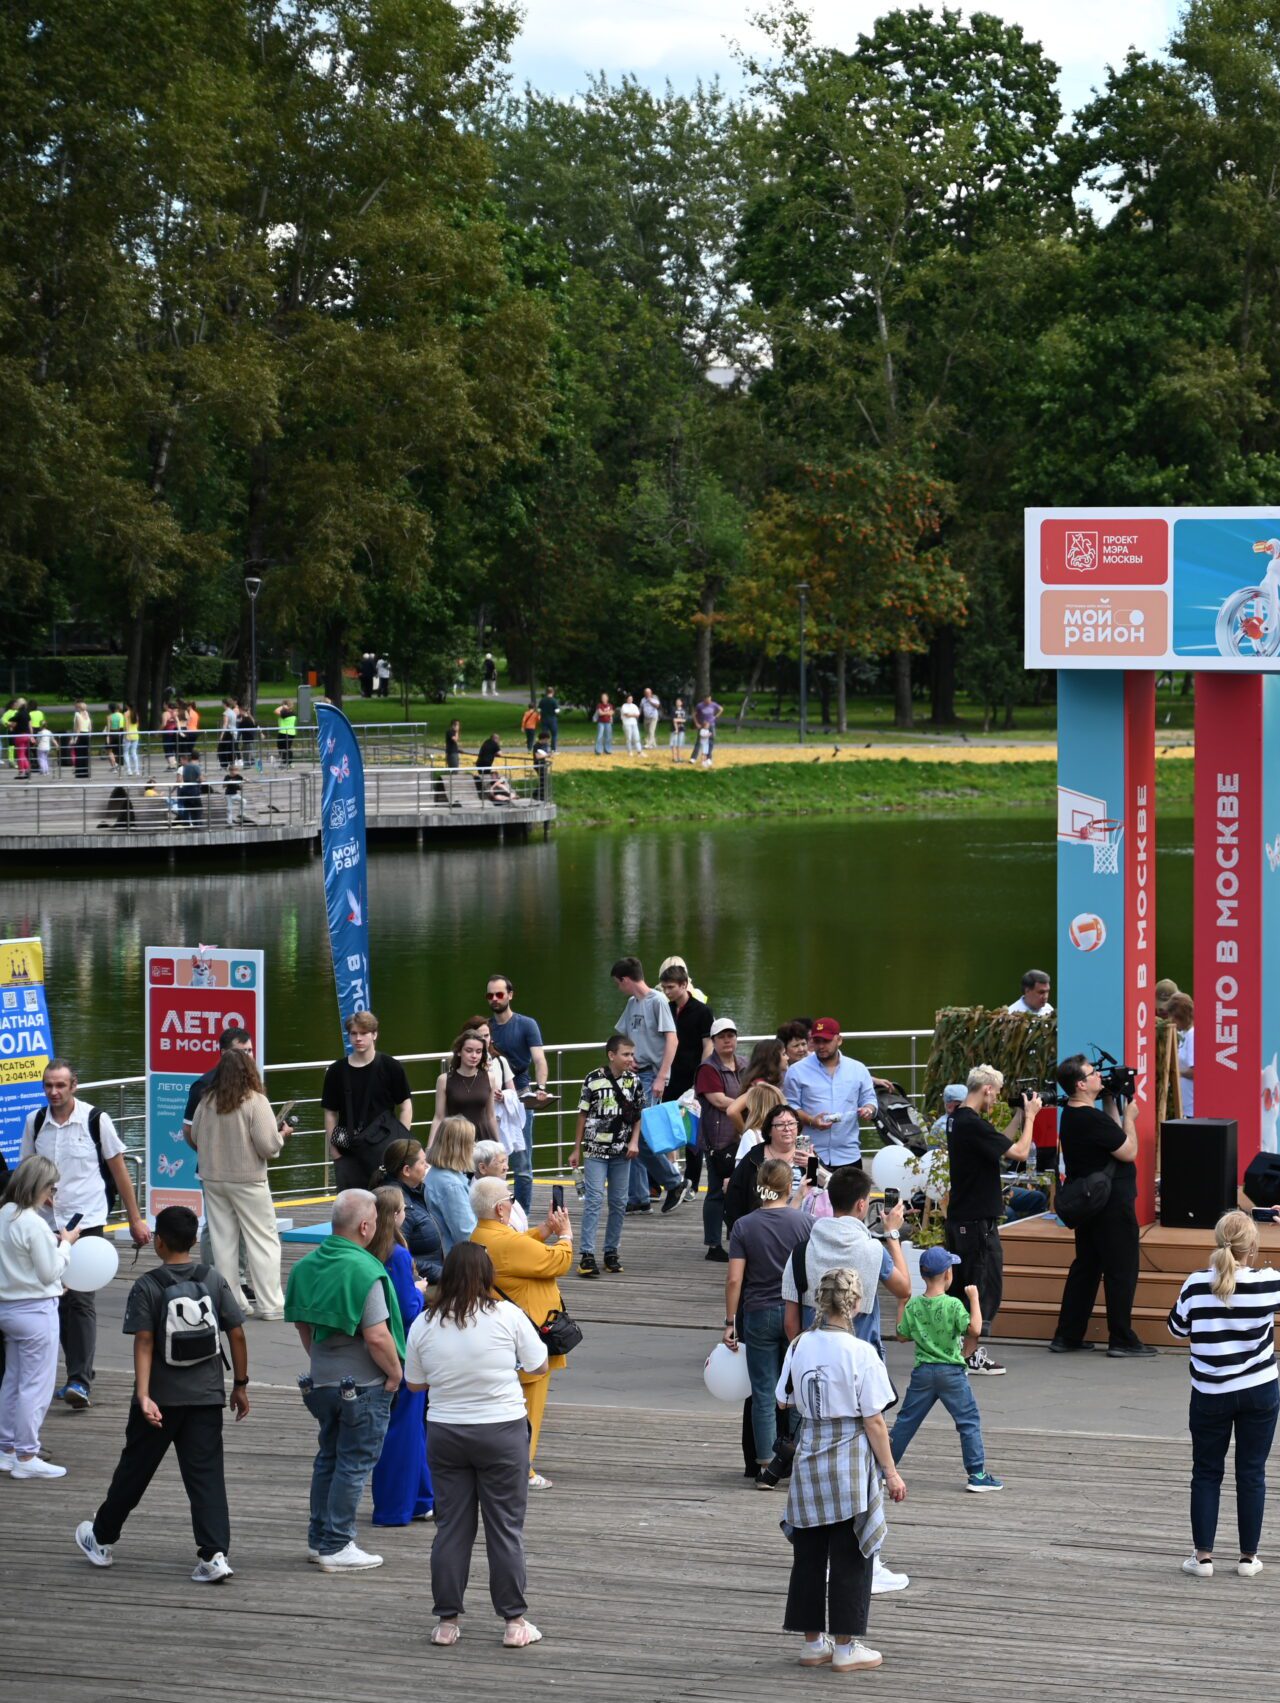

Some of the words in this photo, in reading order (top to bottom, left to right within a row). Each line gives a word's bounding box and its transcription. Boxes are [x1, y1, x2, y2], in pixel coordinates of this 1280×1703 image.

[1102, 535, 1139, 544] ПРОЕКТ
[1102, 545, 1129, 554] МЭРА
[1102, 555, 1143, 564] МОСКВЫ
[1215, 773, 1239, 927] МОСКВЕ
[1136, 785, 1147, 950] МОСКВЕ
[1215, 940, 1239, 964] В
[1136, 963, 1147, 989] В
[160, 1009, 245, 1034] ЛЕТО
[1215, 975, 1239, 1071] ЛЕТО
[160, 1038, 171, 1050] В
[176, 1039, 220, 1052] МОСК
[1136, 1001, 1148, 1102] ЛЕТО
[6, 1070, 42, 1082] 2-041-941
[157, 1082, 183, 1091] ЛЕТО
